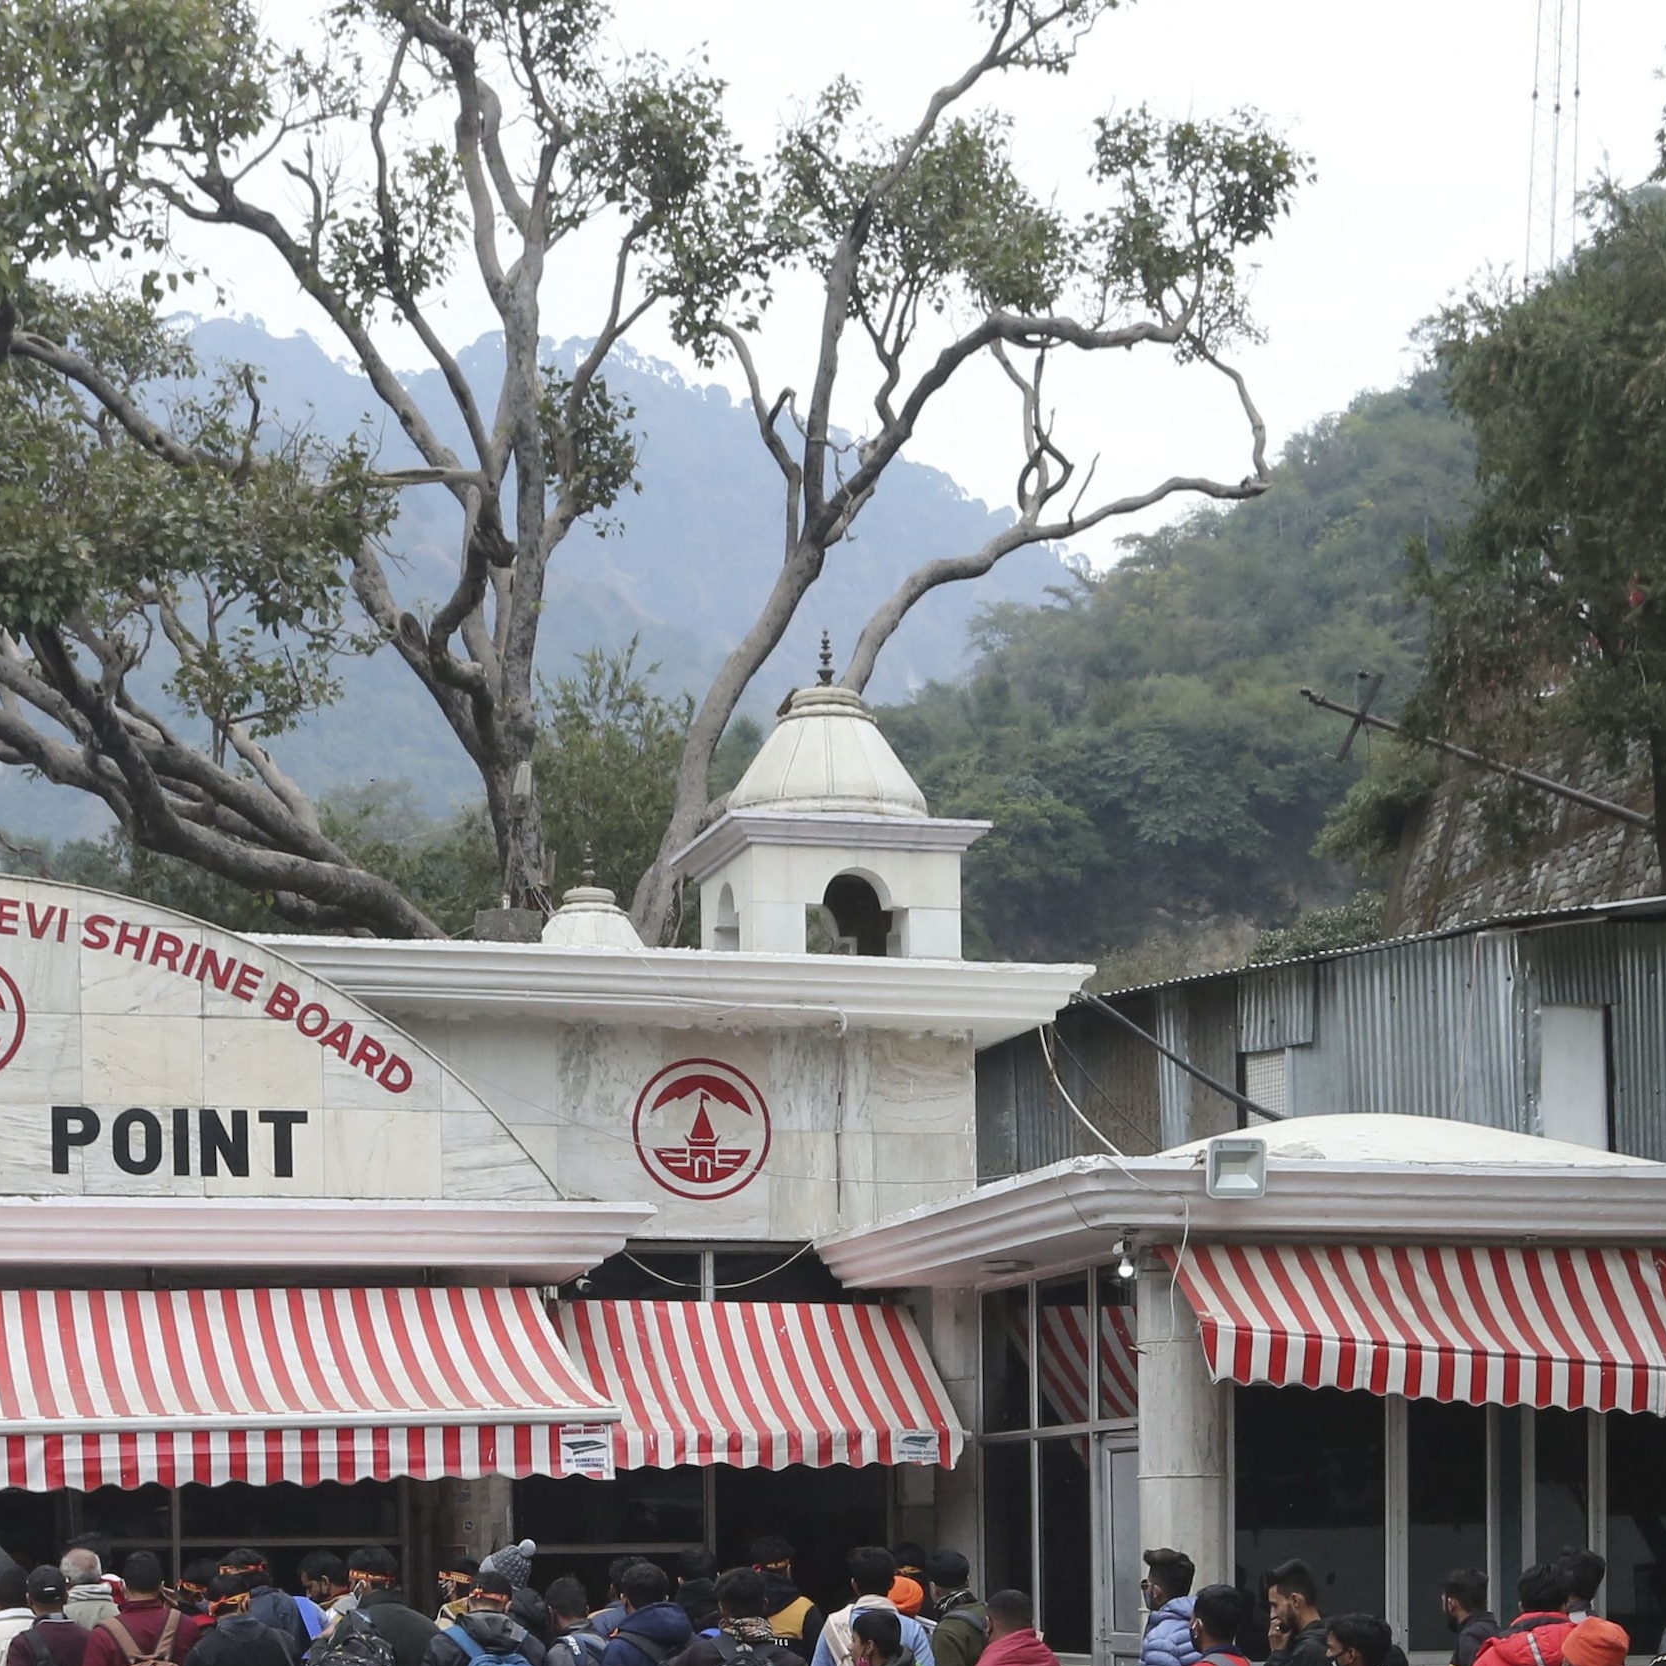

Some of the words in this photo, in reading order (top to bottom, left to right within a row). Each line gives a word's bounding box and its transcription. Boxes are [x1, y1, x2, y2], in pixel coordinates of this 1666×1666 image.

[82, 914, 264, 1002] SHRINE
[264, 981, 413, 1093] BOARD
[52, 1107, 308, 1178] POINT
